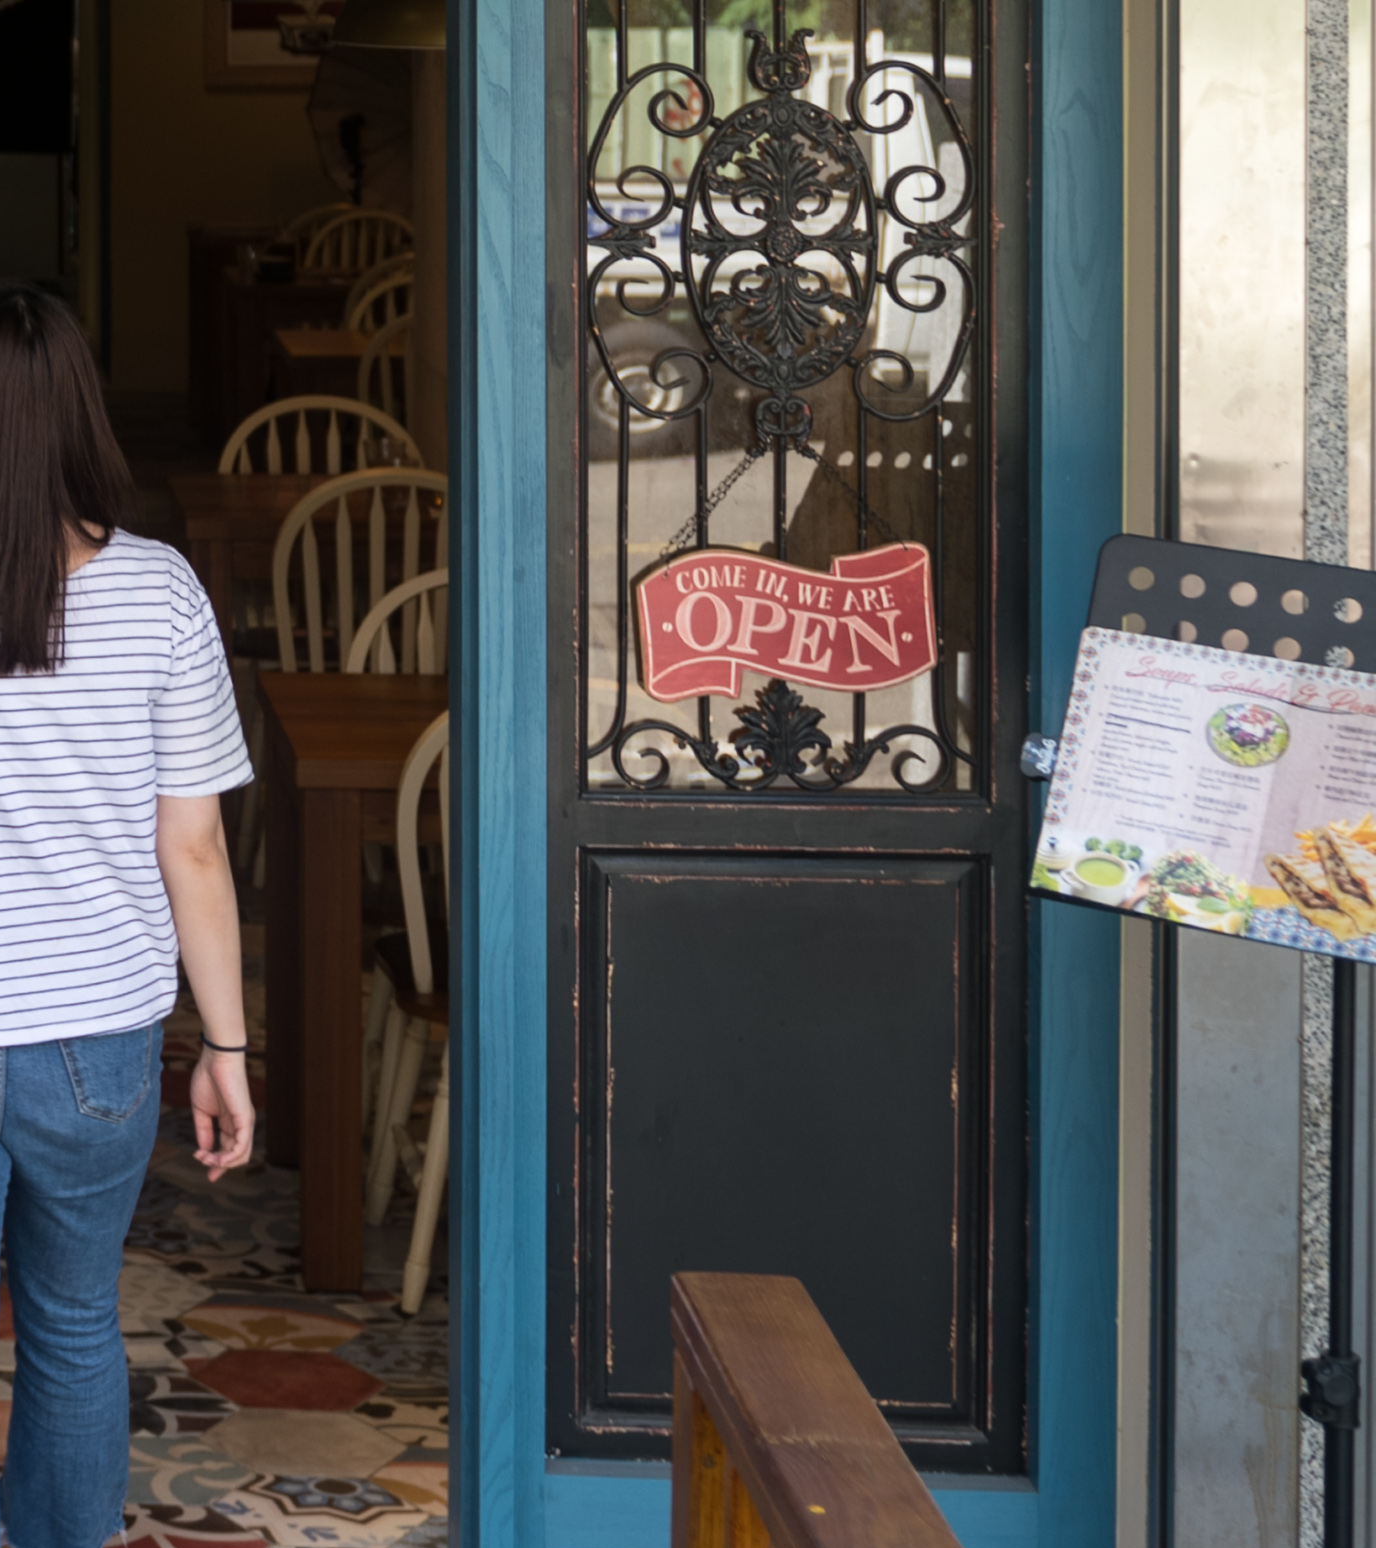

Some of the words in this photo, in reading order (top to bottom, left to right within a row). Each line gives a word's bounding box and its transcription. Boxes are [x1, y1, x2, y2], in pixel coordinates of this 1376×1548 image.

[675, 564, 747, 594] COME
[755, 569, 789, 603] IN,
[797, 582, 833, 610] WE
[842, 585, 896, 612] ARE
[675, 591, 902, 674] OPEN
